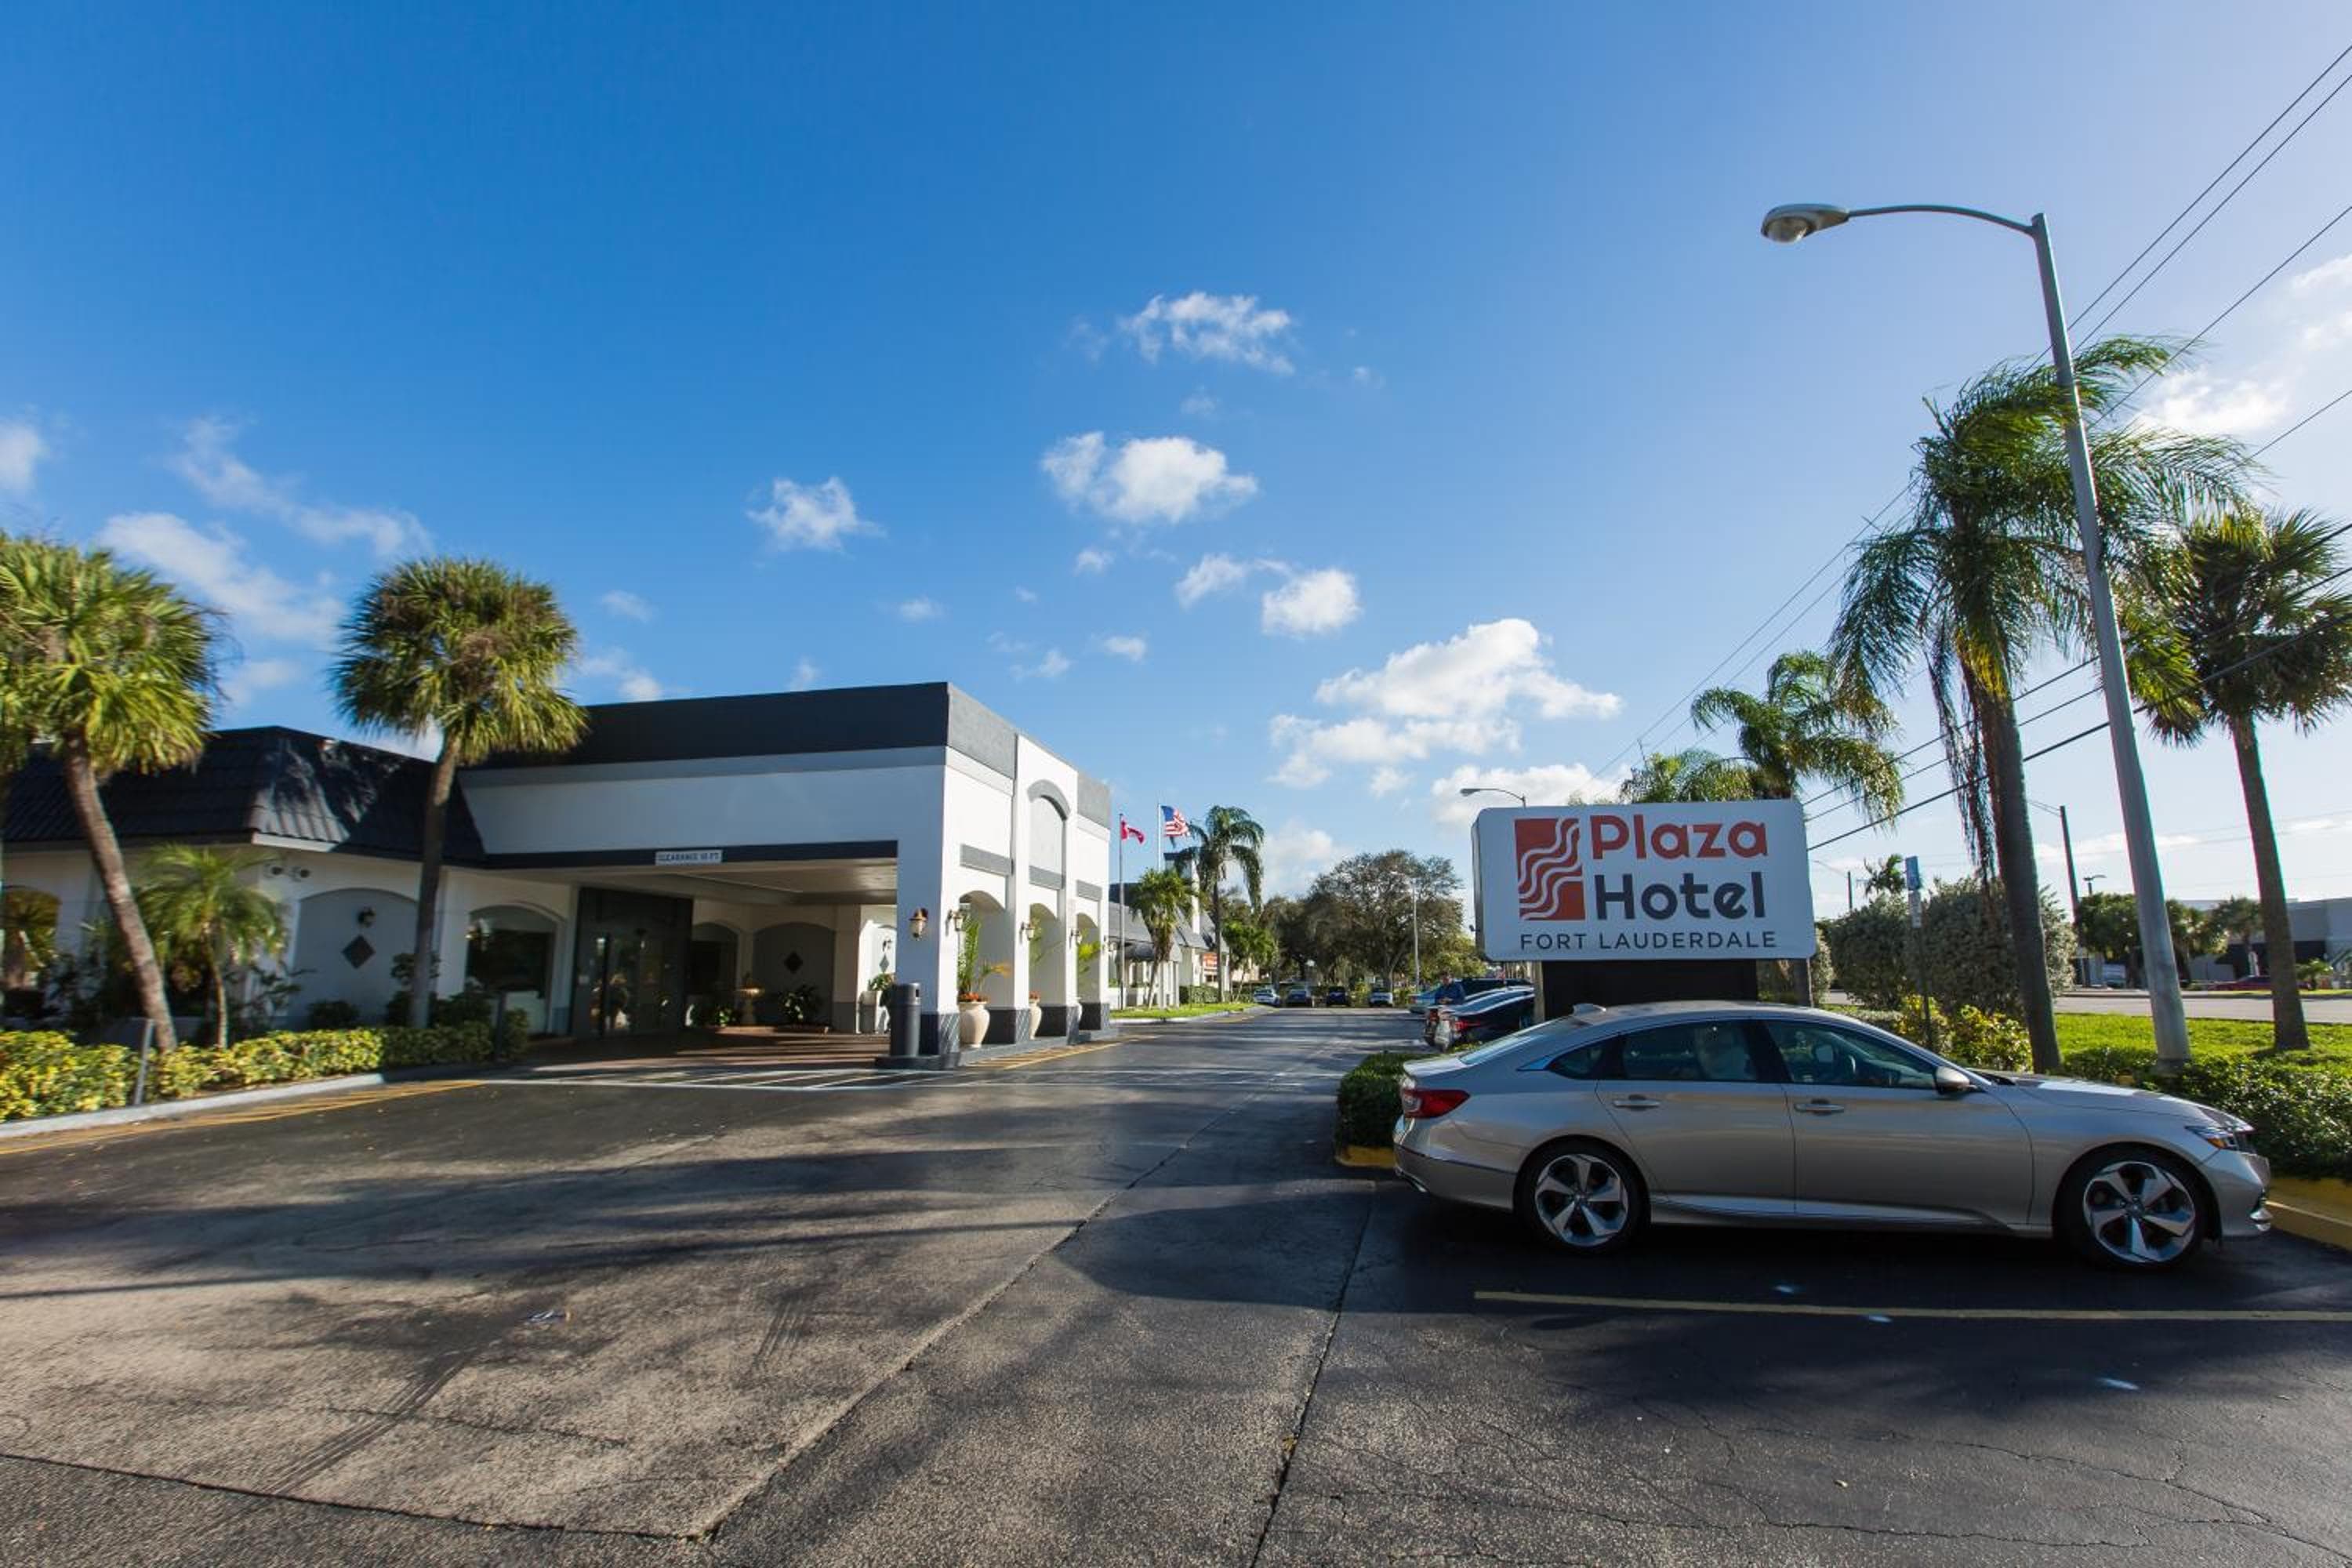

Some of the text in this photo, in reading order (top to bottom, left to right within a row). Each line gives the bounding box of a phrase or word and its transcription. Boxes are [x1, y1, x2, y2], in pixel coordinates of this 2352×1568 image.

[1589, 814, 1769, 861] Plaza
[1594, 871, 1766, 920] Hotel
[1520, 931, 1777, 950] FORT LAUDERDALE
